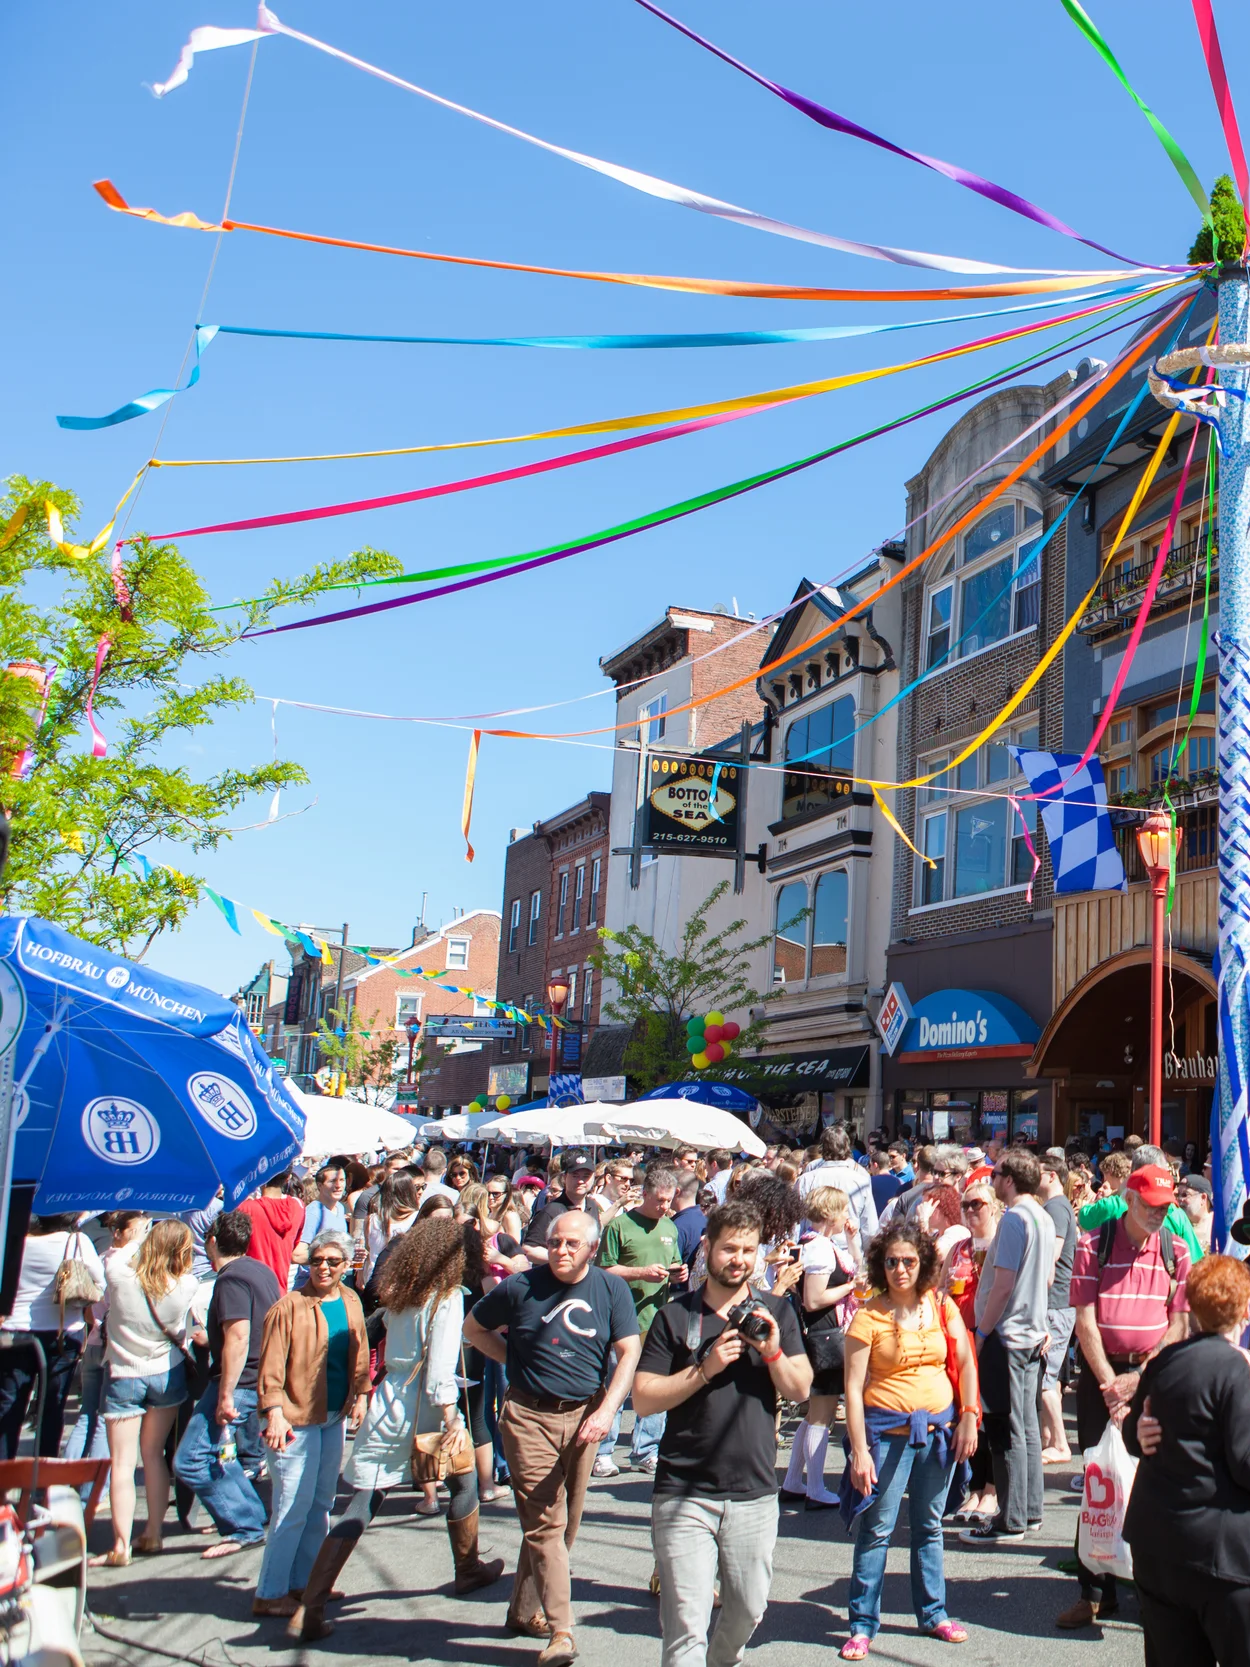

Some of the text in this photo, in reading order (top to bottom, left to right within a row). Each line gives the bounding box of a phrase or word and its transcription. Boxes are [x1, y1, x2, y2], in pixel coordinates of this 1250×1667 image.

[652, 760, 737, 779] WELCOME TO
[682, 801, 708, 810] of the
[672, 809, 709, 821] SEA
[652, 832, 728, 845] 215-627-9510
[25, 941, 208, 1024] HOFBRÄU MÜNCHEN
[919, 1010, 988, 1048] Domino's
[764, 1062, 794, 1077] THE
[796, 1059, 830, 1075] SEA
[1165, 1050, 1219, 1079] Brauha
